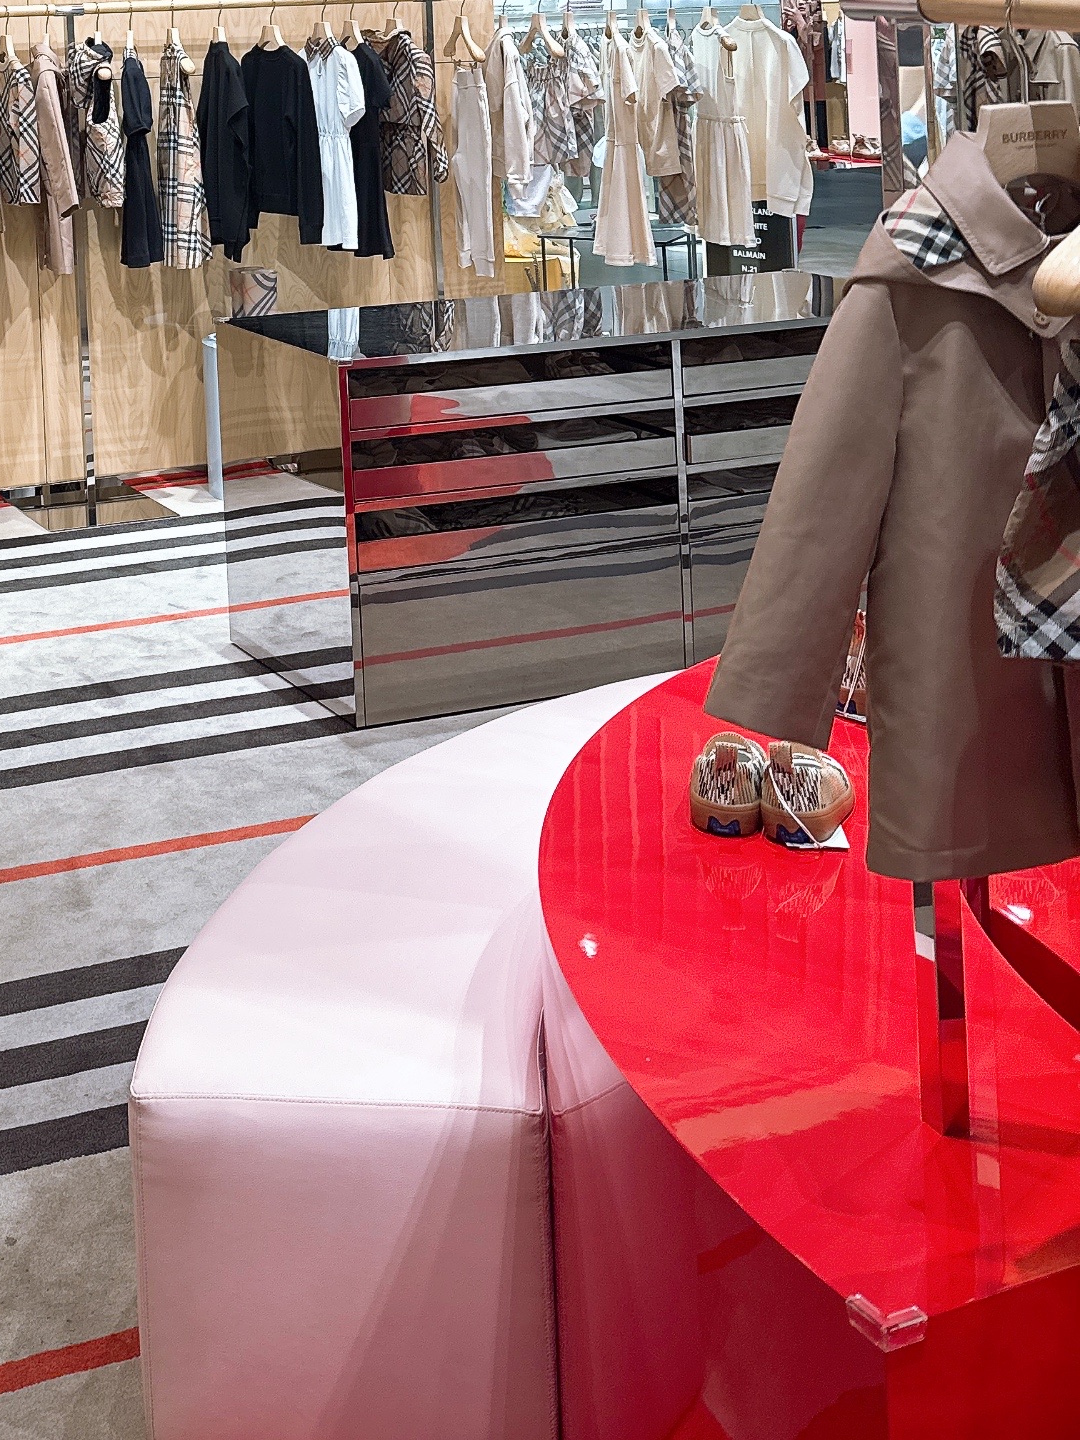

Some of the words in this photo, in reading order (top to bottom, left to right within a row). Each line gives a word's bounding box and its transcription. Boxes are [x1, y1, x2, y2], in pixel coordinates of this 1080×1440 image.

[1001, 128, 1068, 144] BURBERRY
[733, 249, 766, 260] BALMAIN
[741, 264, 758, 273] N.21
